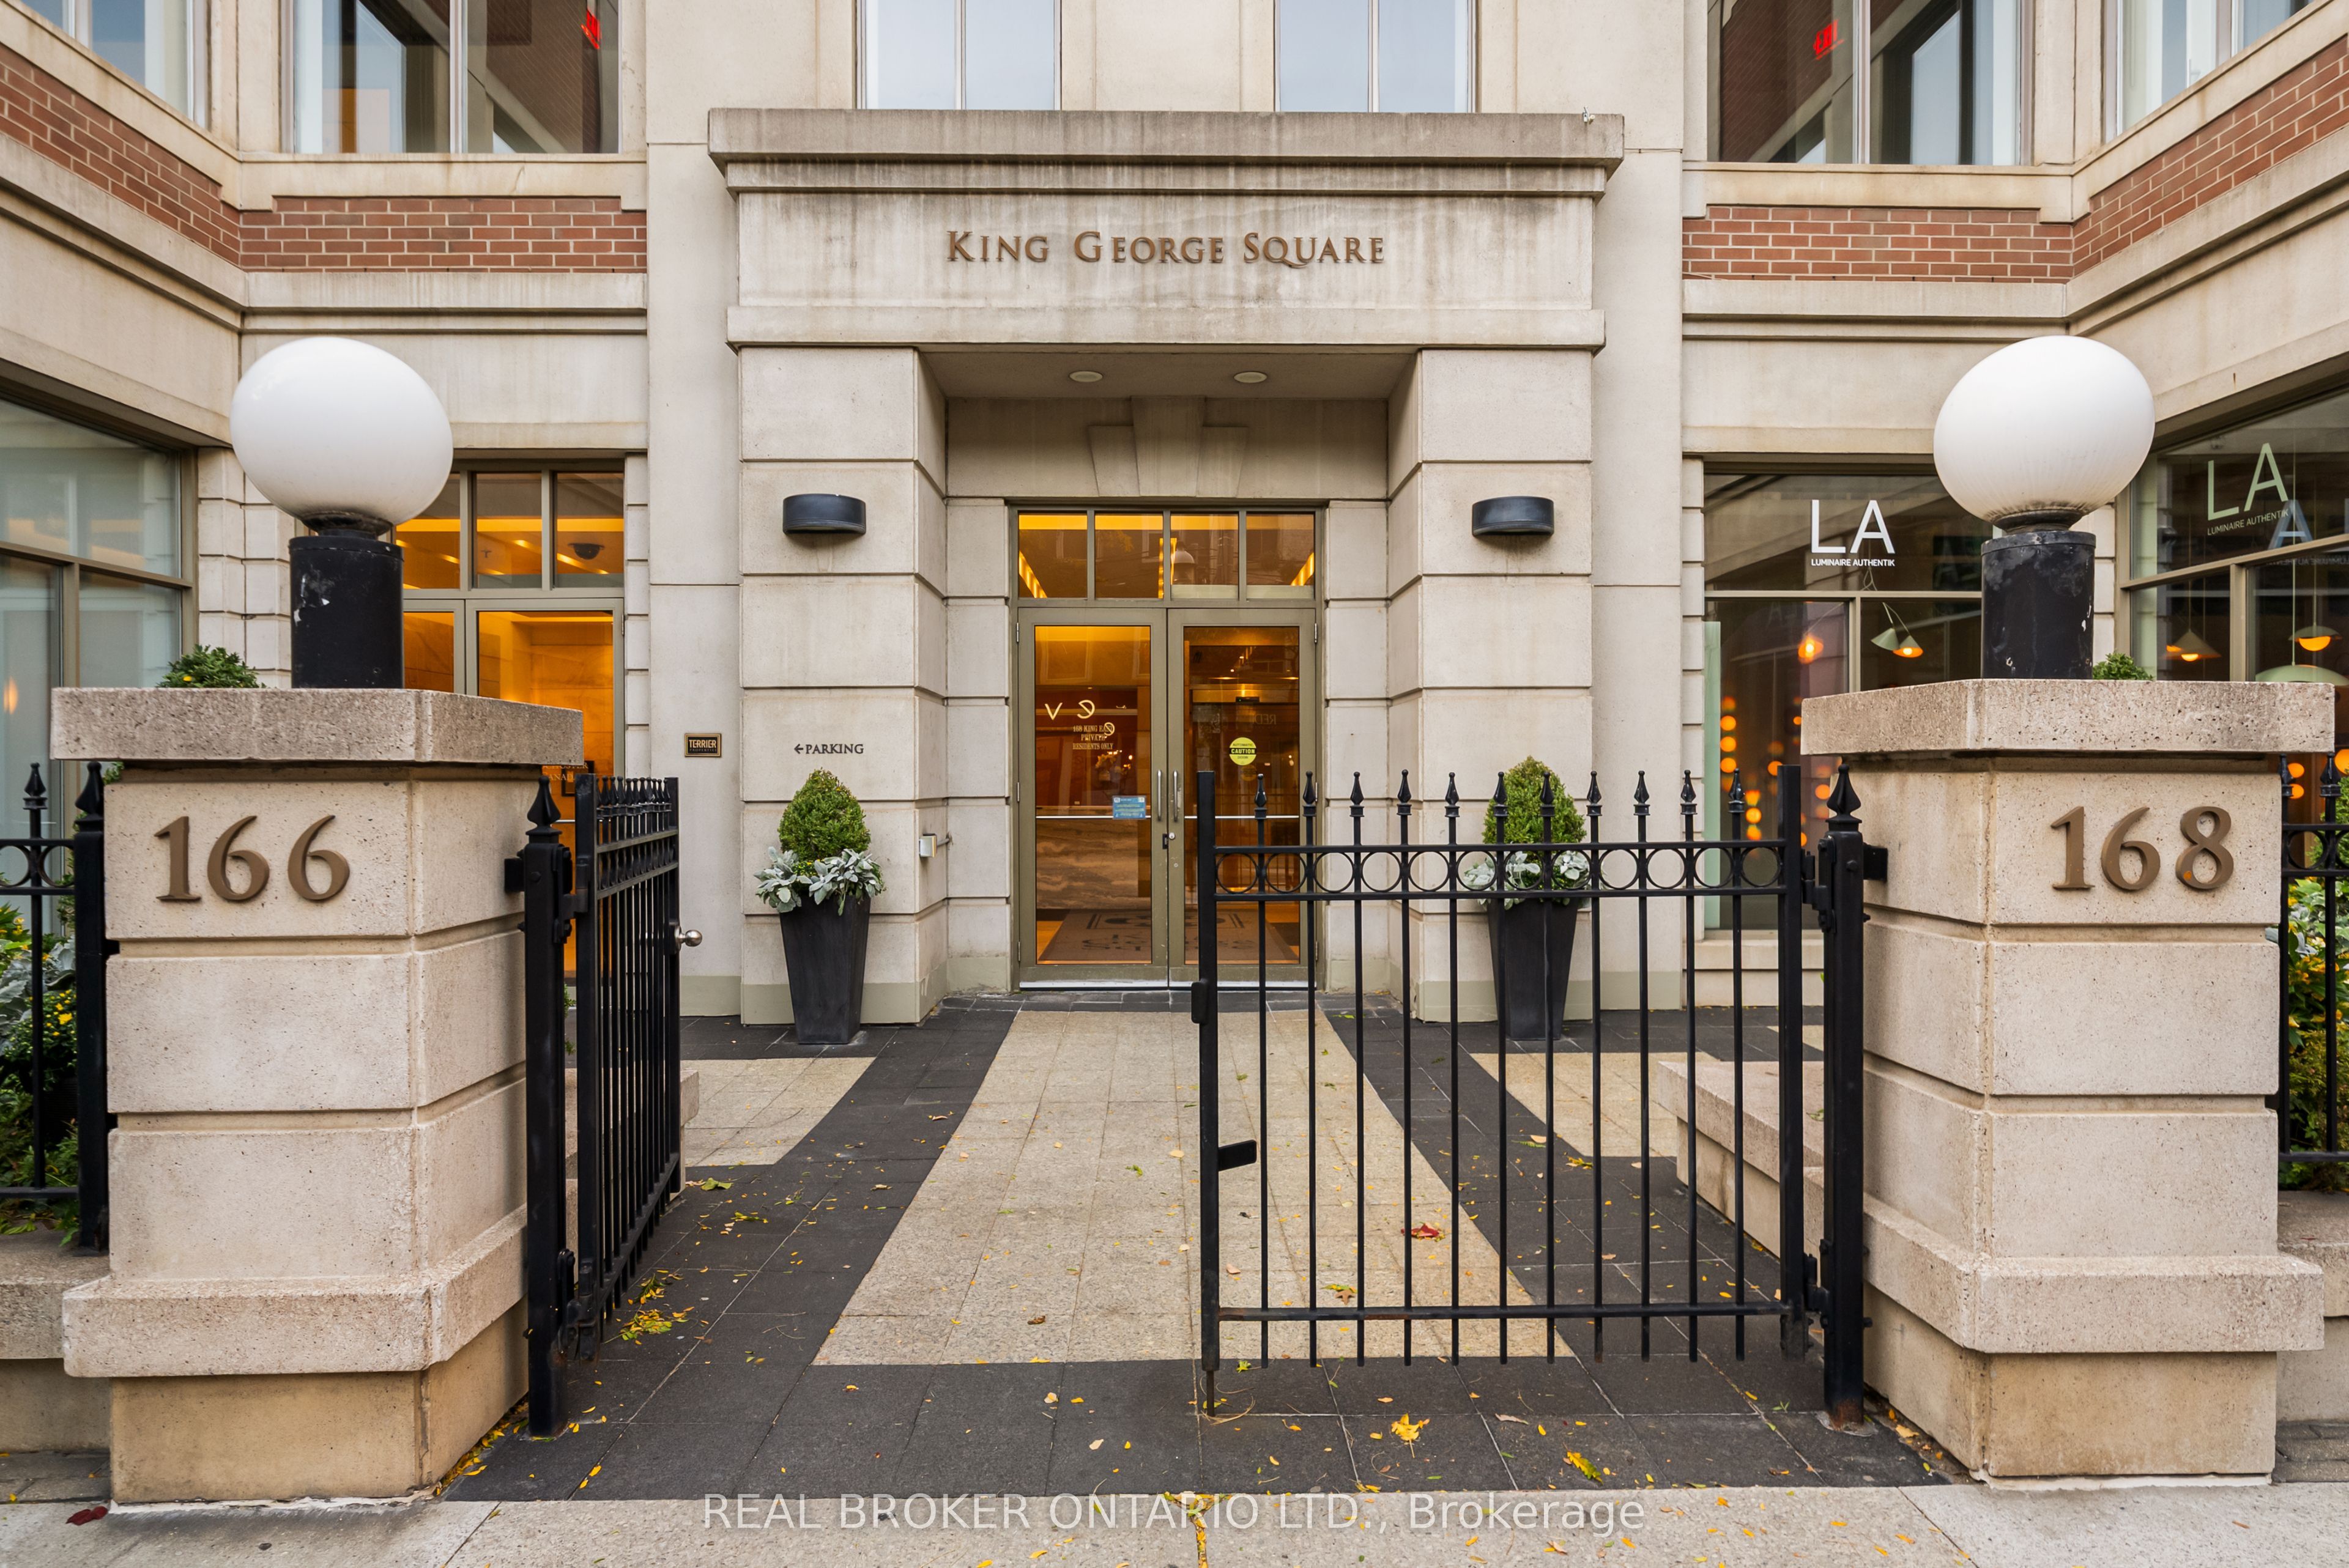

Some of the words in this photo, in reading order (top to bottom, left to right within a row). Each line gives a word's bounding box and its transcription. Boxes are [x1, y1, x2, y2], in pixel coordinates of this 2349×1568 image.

[947, 230, 1049, 262] KING
[1074, 231, 1224, 264] GEORGE
[1243, 232, 1384, 268] SQUARE
[2207, 442, 2288, 521] LA
[1811, 500, 1895, 553] LA
[2207, 519, 2245, 536] LUMINAIRE
[2246, 508, 2289, 526] AUTHENTIK
[689, 739, 717, 748] TERRIER
[806, 744, 864, 754] PARKING
[154, 815, 351, 901] 166
[2050, 806, 2234, 891] 168
